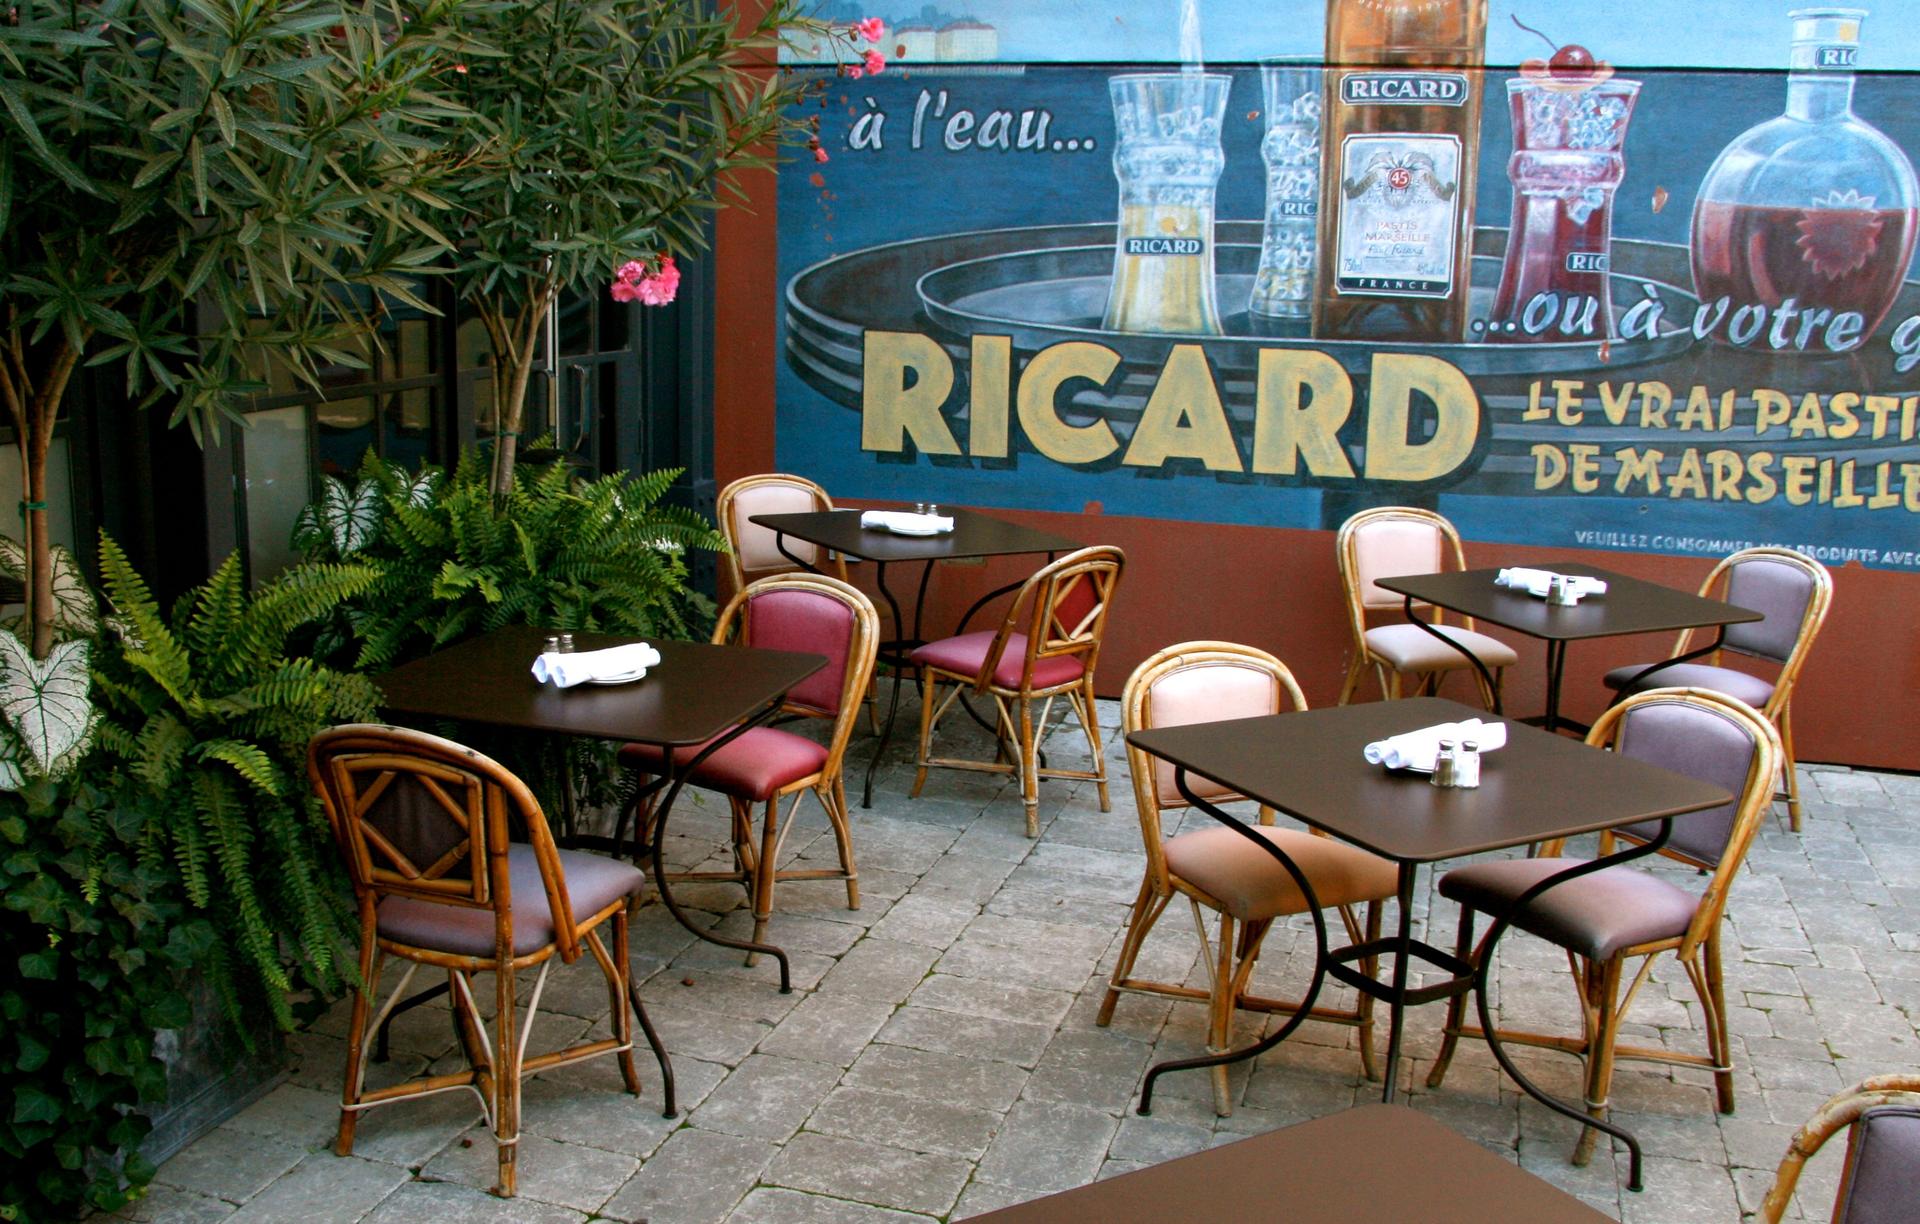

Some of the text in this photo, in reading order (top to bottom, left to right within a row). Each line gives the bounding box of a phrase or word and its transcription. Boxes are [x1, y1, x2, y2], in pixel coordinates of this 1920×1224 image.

[1351, 80, 1457, 99] RICARD
[849, 89, 1094, 150] à l'eau...
[1391, 171, 1408, 185] 45
[1284, 202, 1315, 215] RIC
[1129, 240, 1200, 253] RICARD
[1359, 279, 1429, 290] FRANCE
[1471, 291, 1599, 335] ...ou
[1619, 283, 1665, 340] à
[1691, 295, 1864, 353] votre
[861, 329, 1480, 482] RICARD
[1522, 379, 1920, 442] LE VRAI PASTI
[1530, 443, 1920, 513] DE MARSEILLE
[1575, 530, 1648, 548] VEUILLEZ
[1797, 545, 1877, 562] PRODUITS
